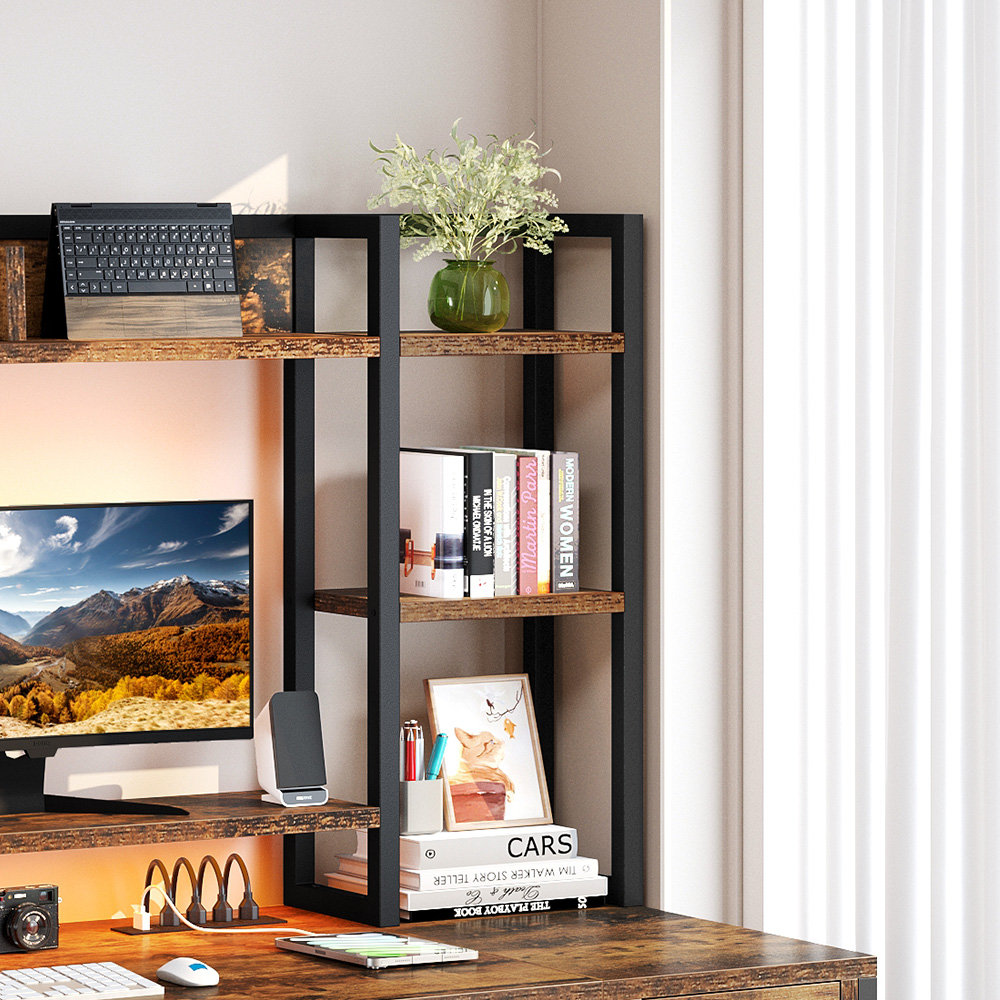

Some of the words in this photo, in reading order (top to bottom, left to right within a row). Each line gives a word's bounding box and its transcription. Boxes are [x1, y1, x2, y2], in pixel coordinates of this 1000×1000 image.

[521, 460, 536, 503] Parr
[565, 458, 574, 502] MODERN
[484, 496, 492, 509] THE
[484, 510, 492, 526] SKIN
[484, 526, 492, 536] OF
[521, 508, 536, 573] Martin
[560, 504, 574, 577] WOMEN
[484, 542, 492, 557] LION
[508, 834, 572, 858] CARS
[473, 870, 508, 883] STORY
[511, 867, 556, 880] WALKER
[558, 865, 577, 876] TIM
[433, 874, 469, 886] TELLER
[465, 889, 482, 905] Co
[498, 886, 540, 900] Death
[530, 901, 551, 911] THE
[577, 896, 587, 909] 50
[454, 906, 482, 917] BOOK
[484, 903, 529, 916] PLAYBOY
